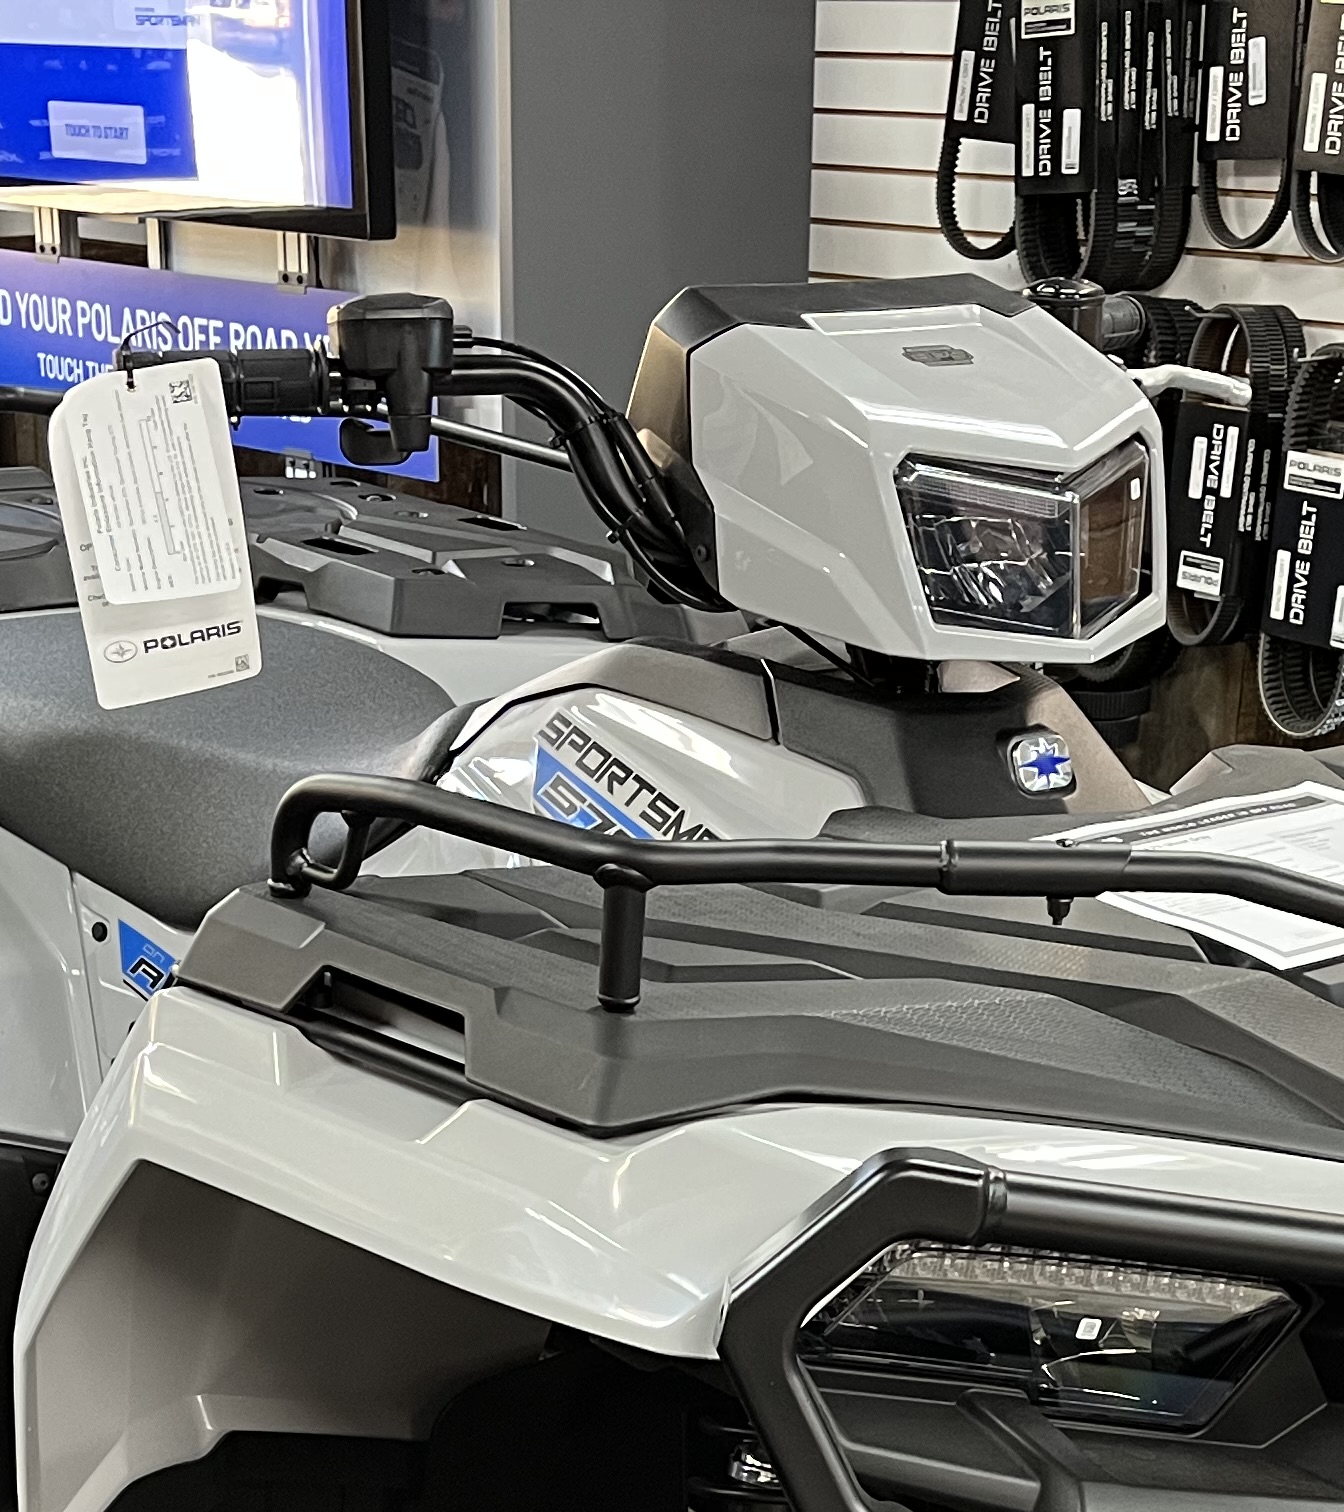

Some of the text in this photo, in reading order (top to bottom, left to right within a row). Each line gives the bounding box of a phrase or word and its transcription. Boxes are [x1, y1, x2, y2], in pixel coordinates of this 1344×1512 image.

[1024, 2, 1071, 17] POLARIS
[974, 0, 1003, 124] DRIVE BELT
[1225, 7, 1247, 142] DRIVE BELT
[65, 123, 129, 141] TOUCH TO START
[1039, 46, 1052, 176] DRIVE BELT
[16, 290, 73, 336] YOUR
[77, 300, 173, 352] POLARIS
[177, 315, 222, 350] OFF
[229, 321, 297, 351] ROAD
[37, 352, 83, 381] TOUCH
[1200, 423, 1224, 548] DRIVE BELT
[1288, 459, 1342, 478] POLARIS
[1181, 571, 1220, 587] POLARIS
[1289, 501, 1318, 625] DRIVE BELT
[143, 620, 243, 653] POLARIS
[537, 772, 633, 840] 57
[538, 710, 722, 841] SPORTSM
